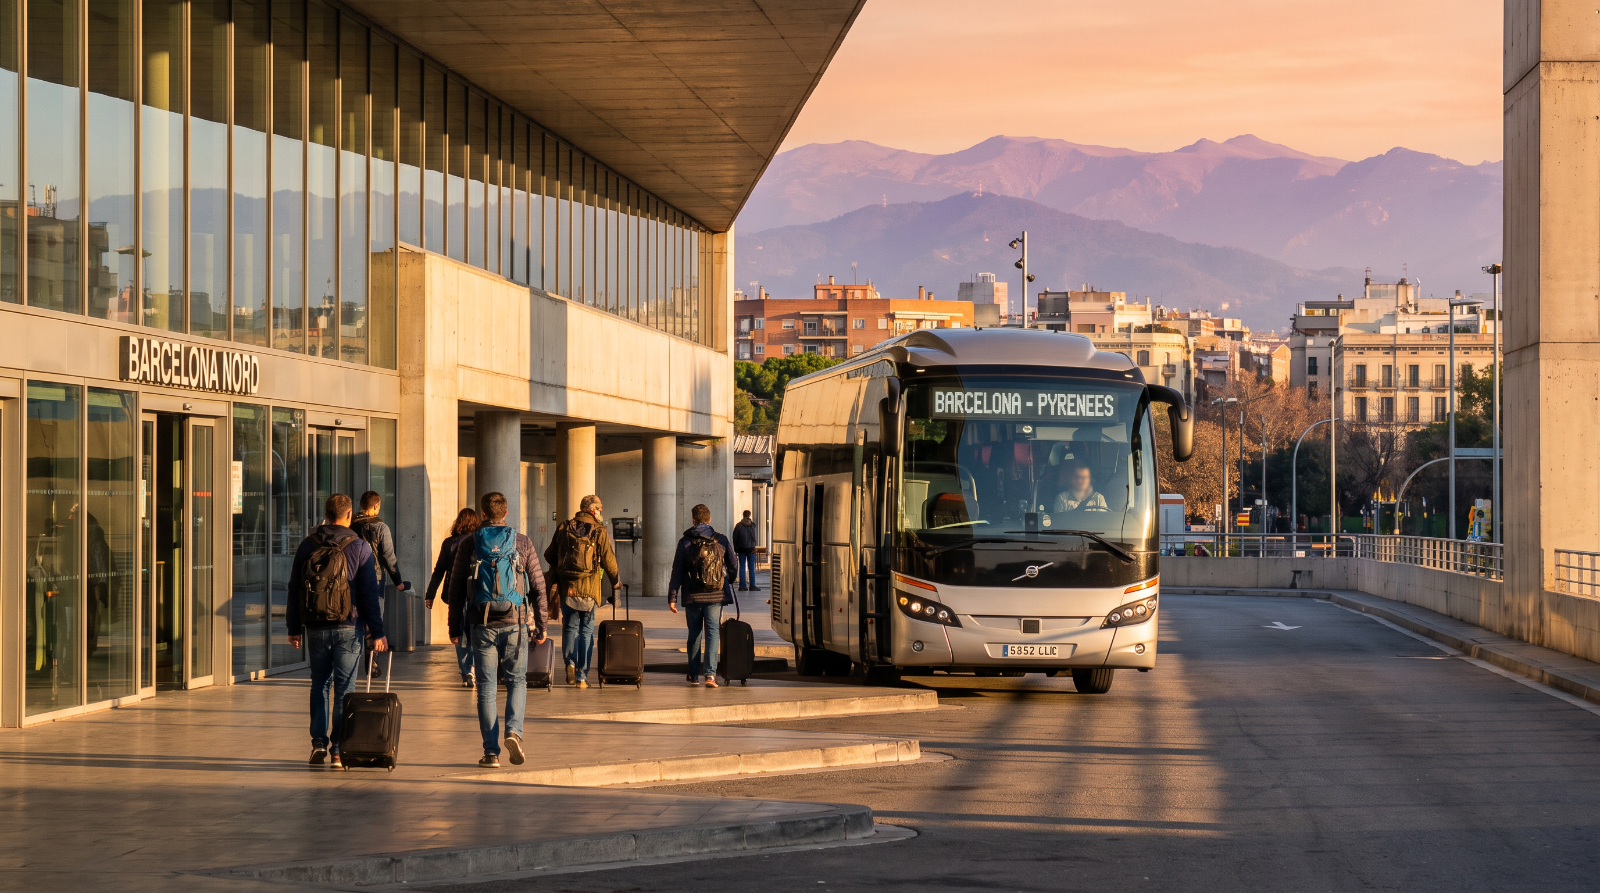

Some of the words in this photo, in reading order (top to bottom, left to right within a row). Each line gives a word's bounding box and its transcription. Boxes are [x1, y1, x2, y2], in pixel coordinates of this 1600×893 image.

[129, 336, 219, 390] BARCELONA
[223, 351, 260, 394] NORD
[934, 391, 1022, 415] BARCELONA
[1037, 393, 1114, 417] PYRENEES
